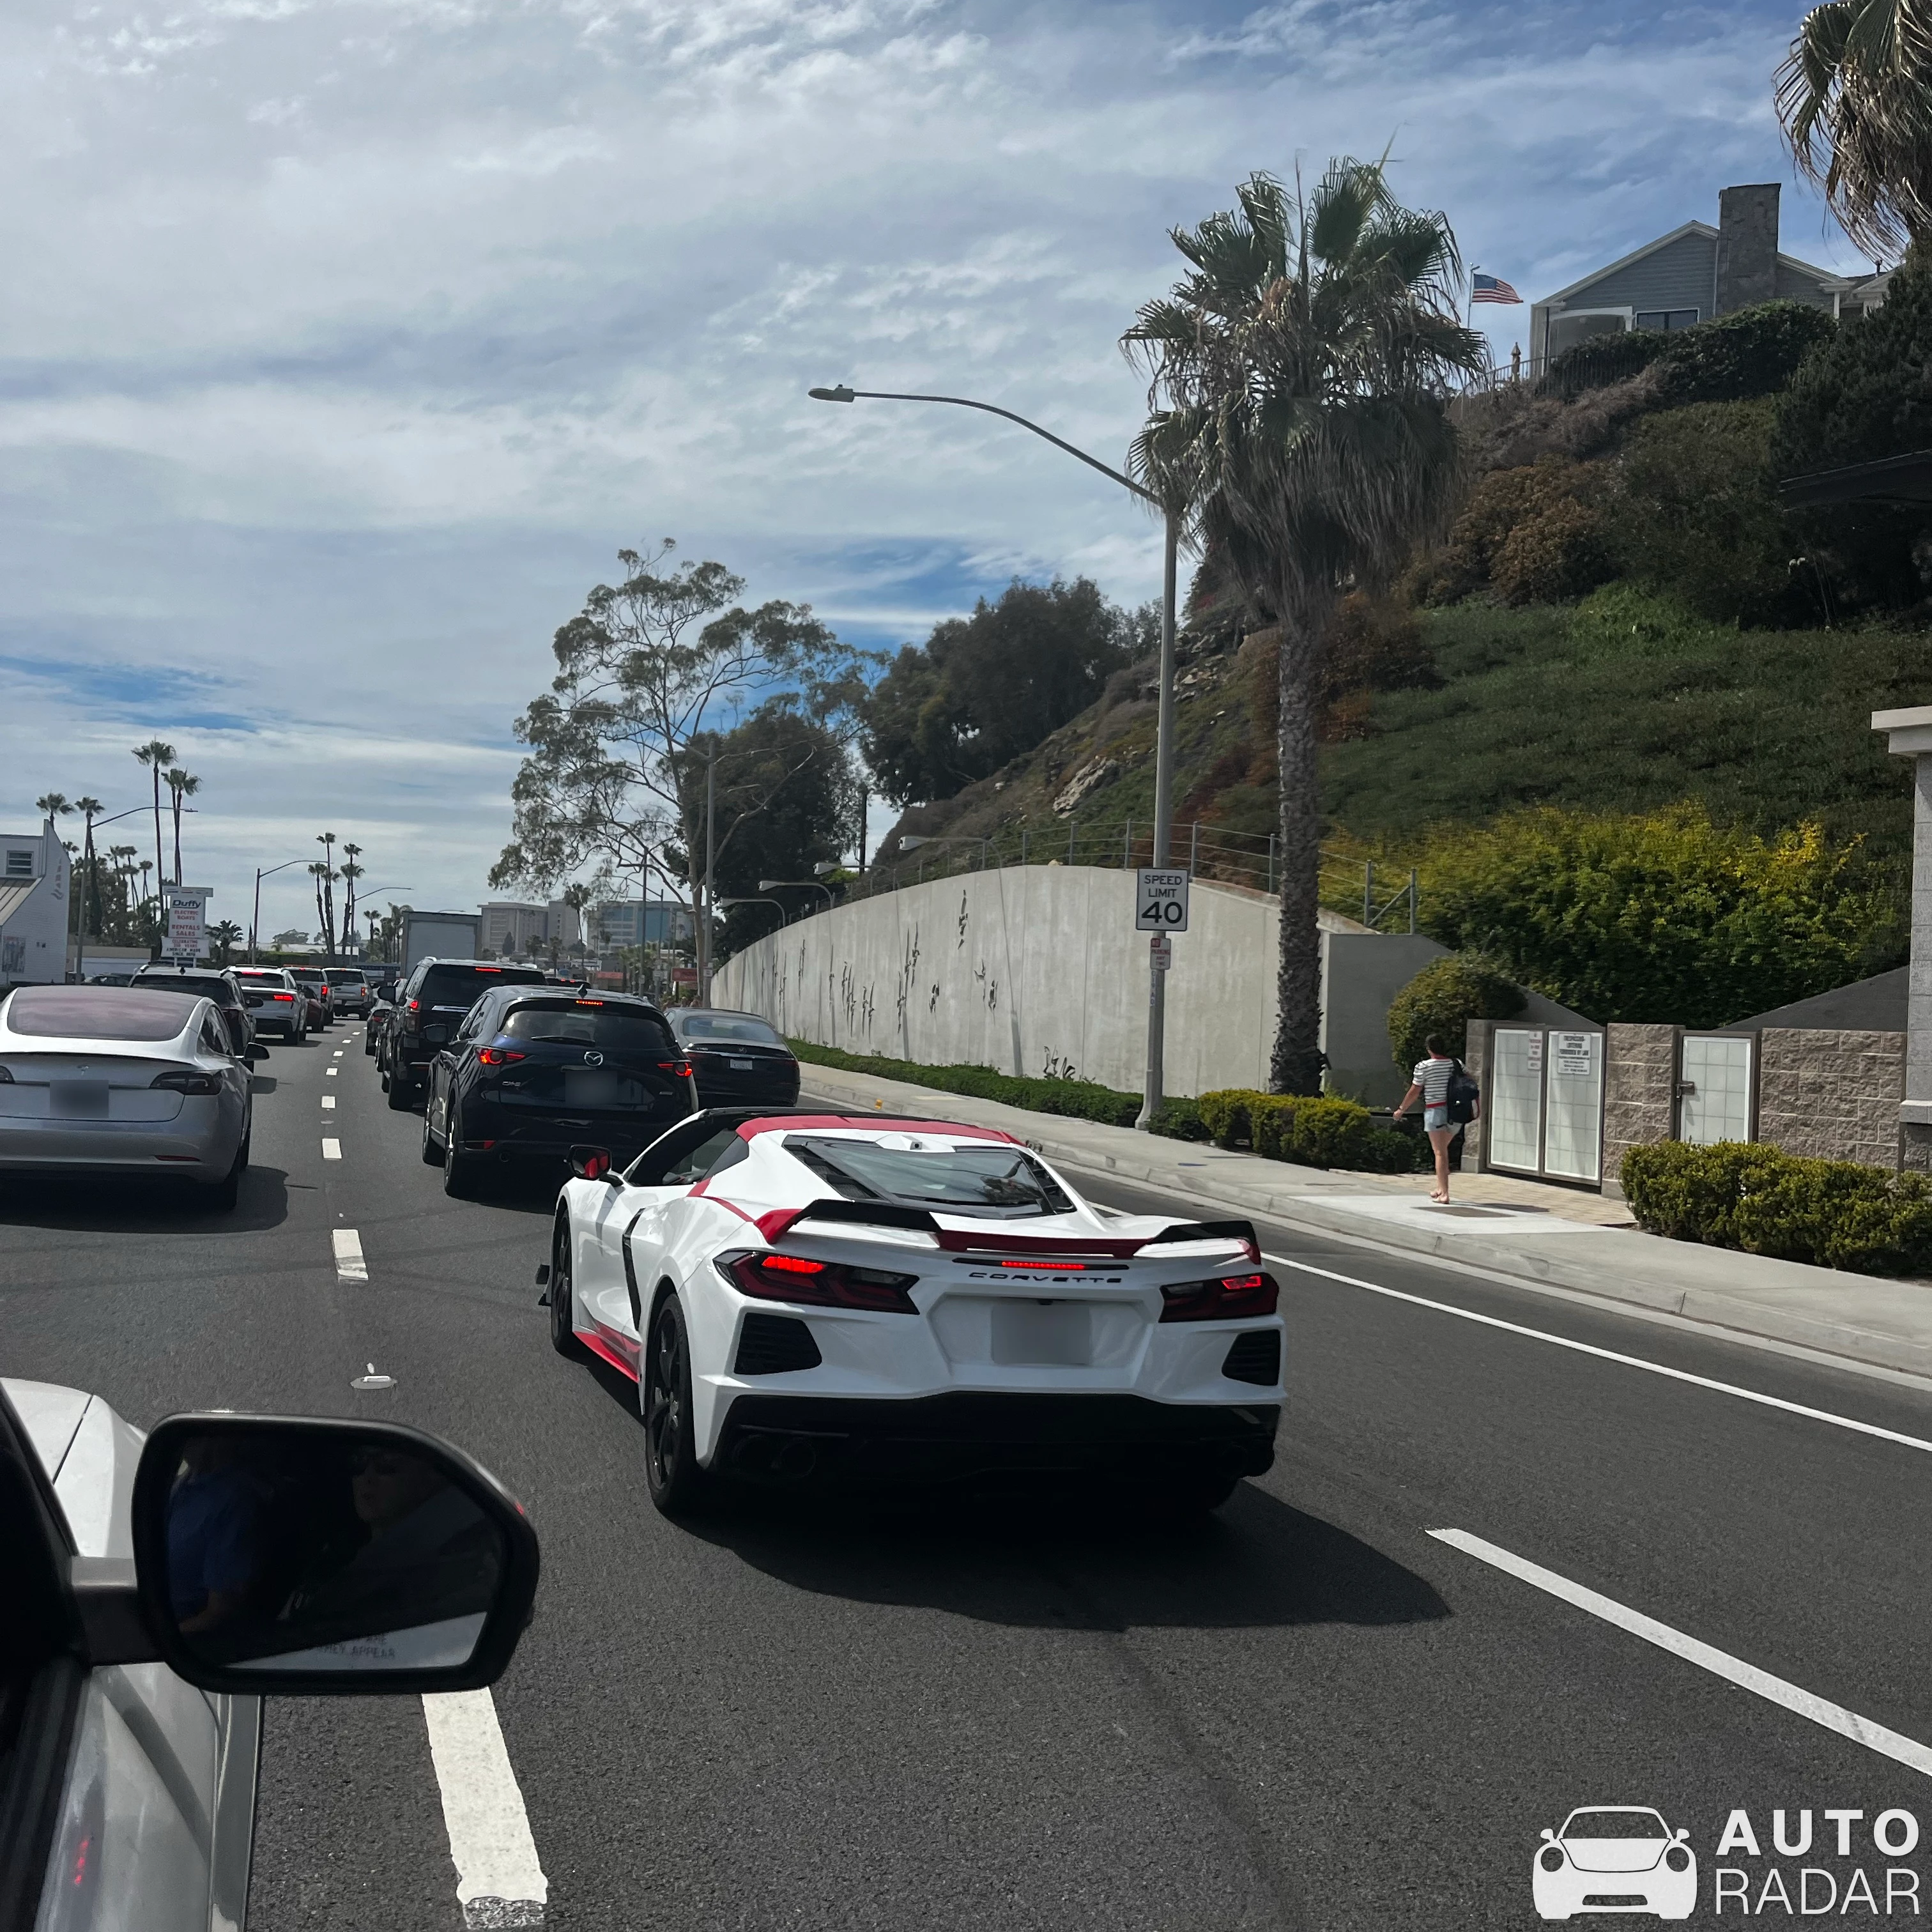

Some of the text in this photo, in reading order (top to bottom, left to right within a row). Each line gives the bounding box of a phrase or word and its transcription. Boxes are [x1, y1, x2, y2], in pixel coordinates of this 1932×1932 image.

[1144, 875, 1183, 885] SPEED
[1148, 888, 1177, 898] LIMIT
[172, 900, 201, 908] Duffy
[1141, 901, 1183, 924] 40
[969, 1272, 1122, 1284] CORVETTE
